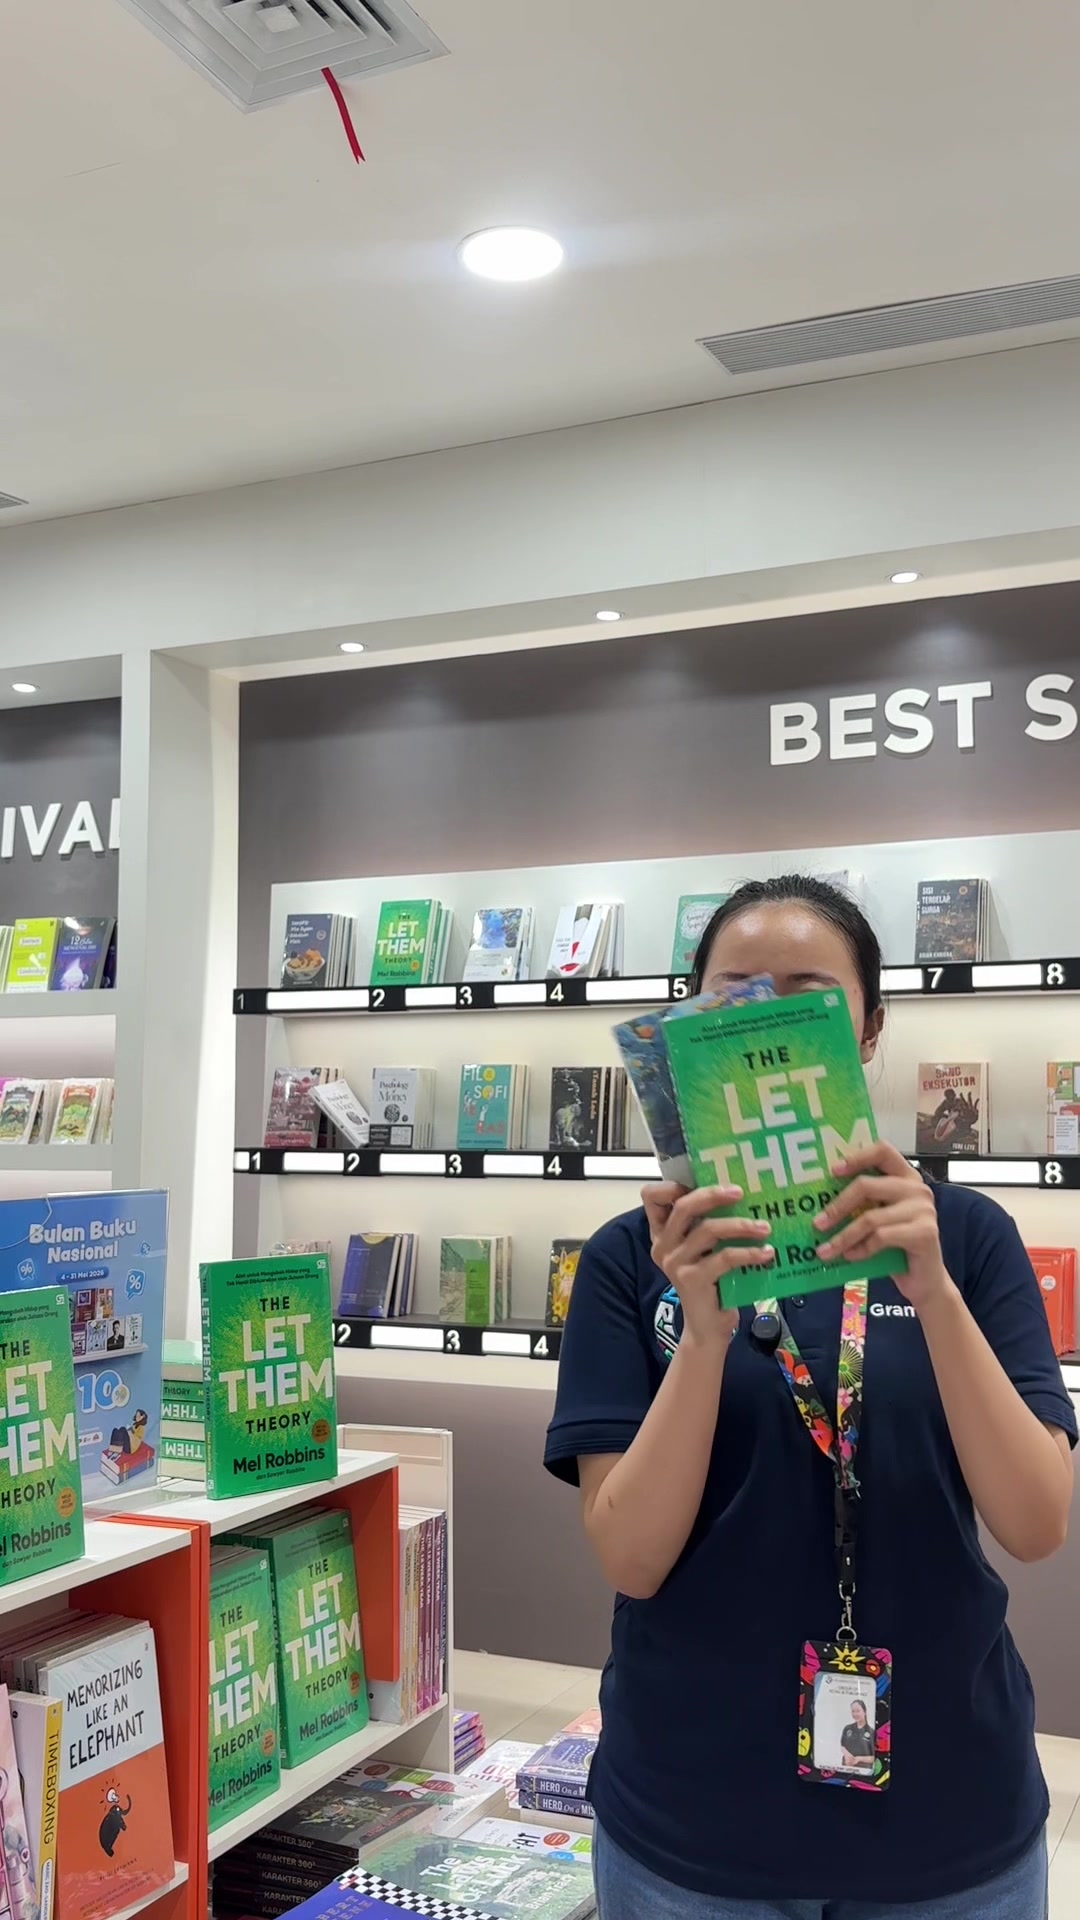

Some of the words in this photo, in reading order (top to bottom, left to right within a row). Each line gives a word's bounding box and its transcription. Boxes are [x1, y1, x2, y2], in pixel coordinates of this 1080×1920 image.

[770, 681, 992, 765] BEST
[1024, 673, 1079, 741] S
[388, 921, 420, 938] LET
[377, 937, 426, 956] THEM
[926, 967, 945, 990] 7
[1046, 962, 1065, 986] 8
[371, 988, 386, 1007] 2
[459, 985, 473, 1005] 3
[550, 982, 565, 1003] 4
[672, 977, 688, 999] 5
[237, 992, 245, 1010] 1
[743, 1045, 792, 1071] THE
[463, 1065, 497, 1082] FILO
[922, 1076, 977, 1091] EKSEKUTOR
[935, 1066, 963, 1079] SANG
[474, 1085, 508, 1100] SOFI
[723, 1064, 828, 1134] LET
[251, 1151, 261, 1171] 1
[346, 1152, 361, 1172] 2
[448, 1154, 462, 1175] 3
[546, 1155, 563, 1176] 4
[700, 1117, 876, 1193] THEM
[1044, 1161, 1064, 1184] 8
[29, 1223, 86, 1244] Bulan
[90, 1218, 137, 1241] Buku
[47, 1241, 119, 1265] Nasional
[201, 1298, 210, 1327] LET
[259, 1296, 291, 1312] THE
[242, 1314, 311, 1362] LET
[337, 1323, 351, 1344] 2
[446, 1329, 461, 1351] 3
[0, 1339, 31, 1360] THE
[533, 1335, 549, 1356] 4
[203, 1332, 212, 1382] THEM
[163, 1386, 191, 1396] THEORY
[218, 1357, 333, 1414] THEM
[161, 1403, 199, 1419] THEM
[245, 1410, 312, 1434] THEORY
[165, 1441, 203, 1458] THEM
[233, 1453, 261, 1475] Mel
[265, 1446, 326, 1470] Robbins
[256, 1473, 267, 1481] dan
[267, 1470, 286, 1480] Sawyer
[11, 1521, 72, 1554] Robbins
[308, 1558, 329, 1578] THE
[298, 1572, 344, 1630] LET
[219, 1605, 243, 1628] THE
[209, 1620, 259, 1686] LET
[285, 1611, 362, 1682] THEM
[67, 1659, 143, 1711] MEMORIZING
[305, 1666, 349, 1699] THEORY
[86, 1703, 108, 1729] LIKE
[113, 1693, 129, 1716] AN
[299, 1717, 319, 1741] Mel
[320, 1699, 359, 1729] Robbins
[69, 1710, 145, 1770] ELEPHANT
[213, 1723, 261, 1763] THEORY
[44, 1729, 60, 1845] TIMEBOXING
[228, 1760, 273, 1798] Robbins
[540, 1780, 560, 1793] HERO
[561, 1786, 573, 1796] On
[542, 1798, 563, 1811] HERO
[563, 1803, 575, 1813] On
[256, 1851, 297, 1866] KARAKTER
[419, 1857, 460, 1877] The
[261, 1870, 302, 1885] KARAKTER
[261, 1905, 285, 1915] KARA
